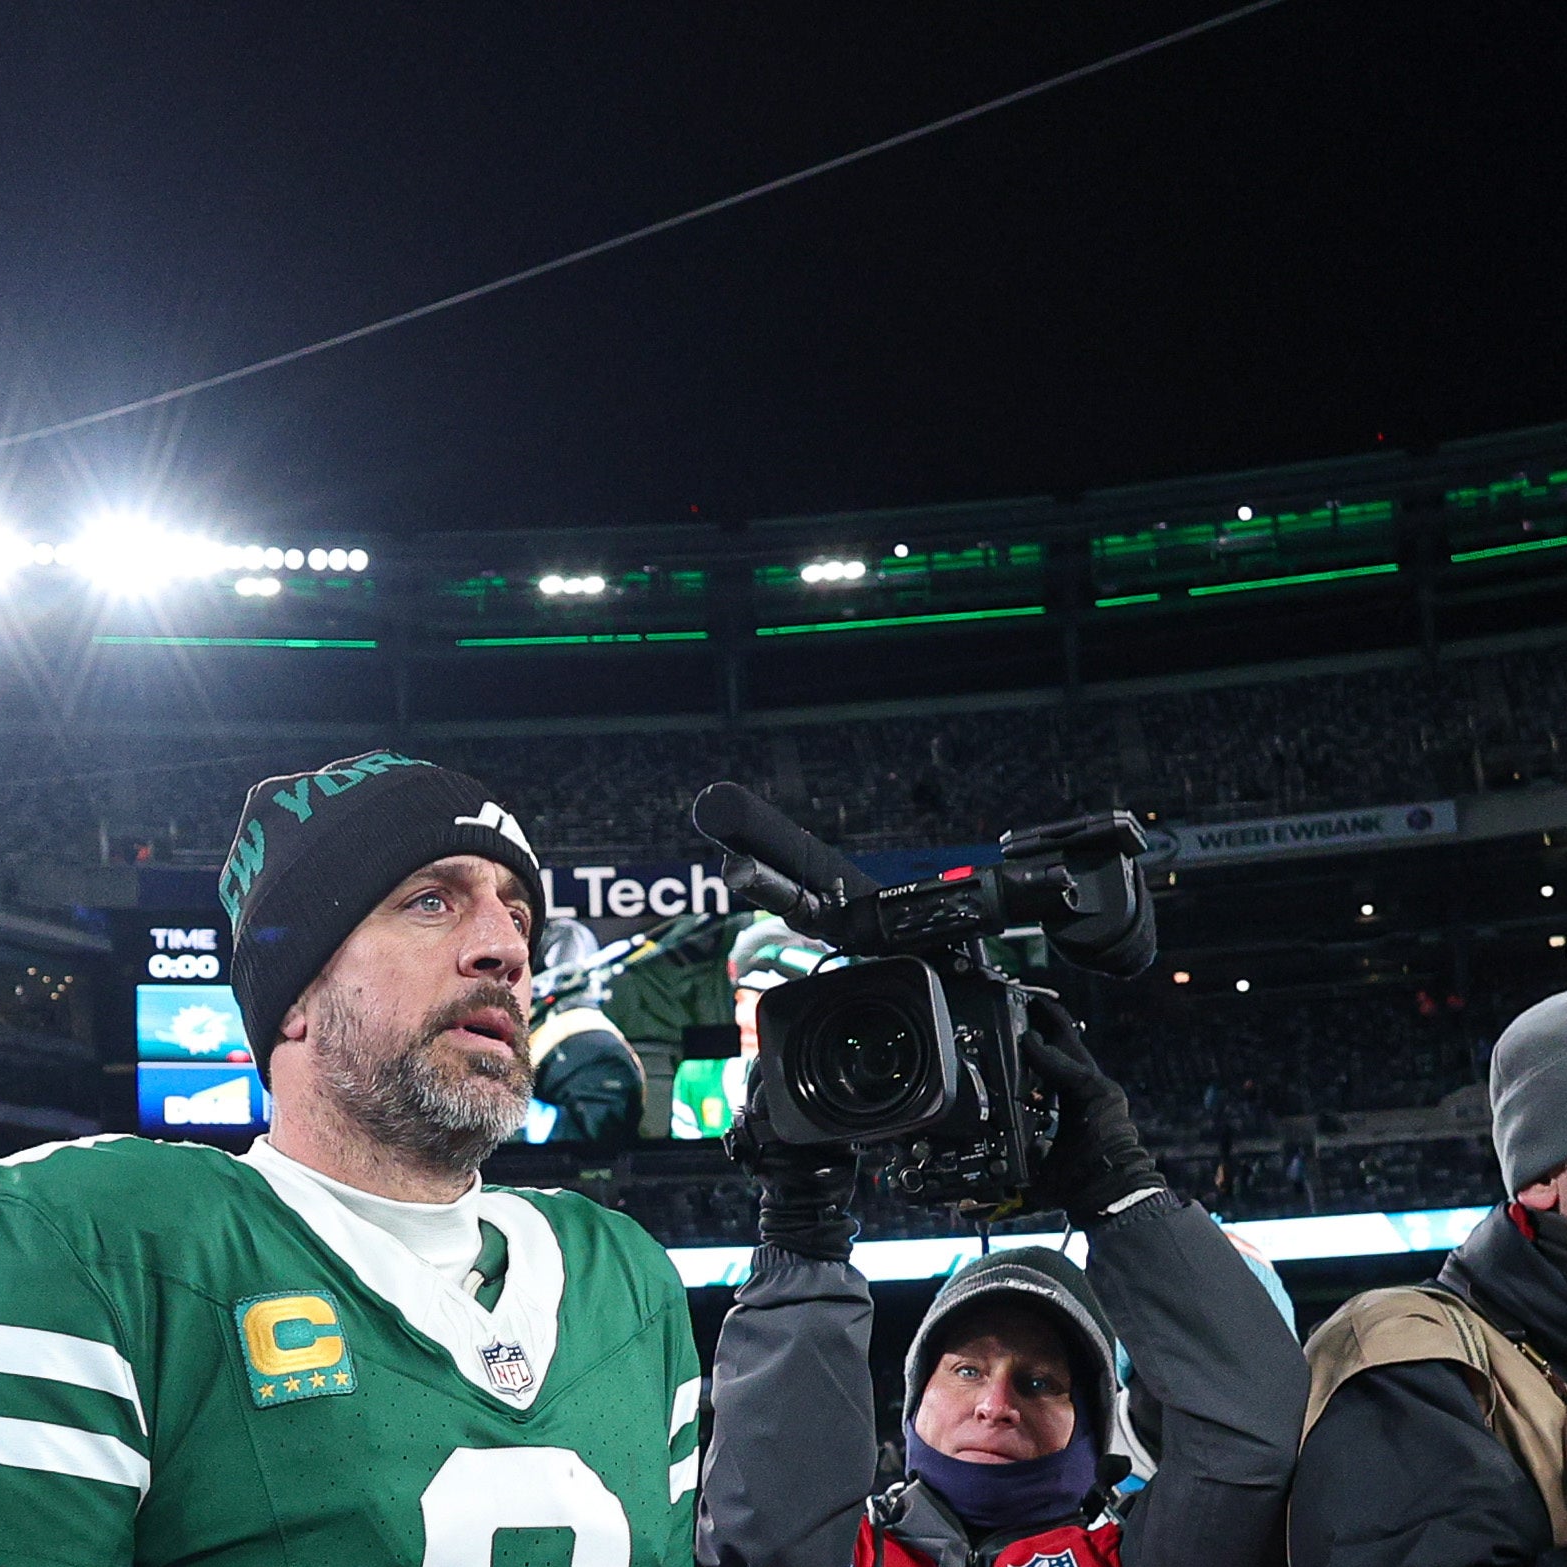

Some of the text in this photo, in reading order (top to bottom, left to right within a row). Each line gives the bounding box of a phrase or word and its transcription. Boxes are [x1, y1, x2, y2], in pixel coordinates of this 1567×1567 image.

[1196, 825, 1271, 851] WEEB
[1273, 814, 1383, 844] EWBANK
[540, 864, 730, 919] LTech
[879, 882, 918, 899] SONY
[149, 928, 217, 950] TIME
[148, 954, 220, 979] 0:00
[243, 1296, 343, 1376] C
[494, 1363, 529, 1386] NFL
